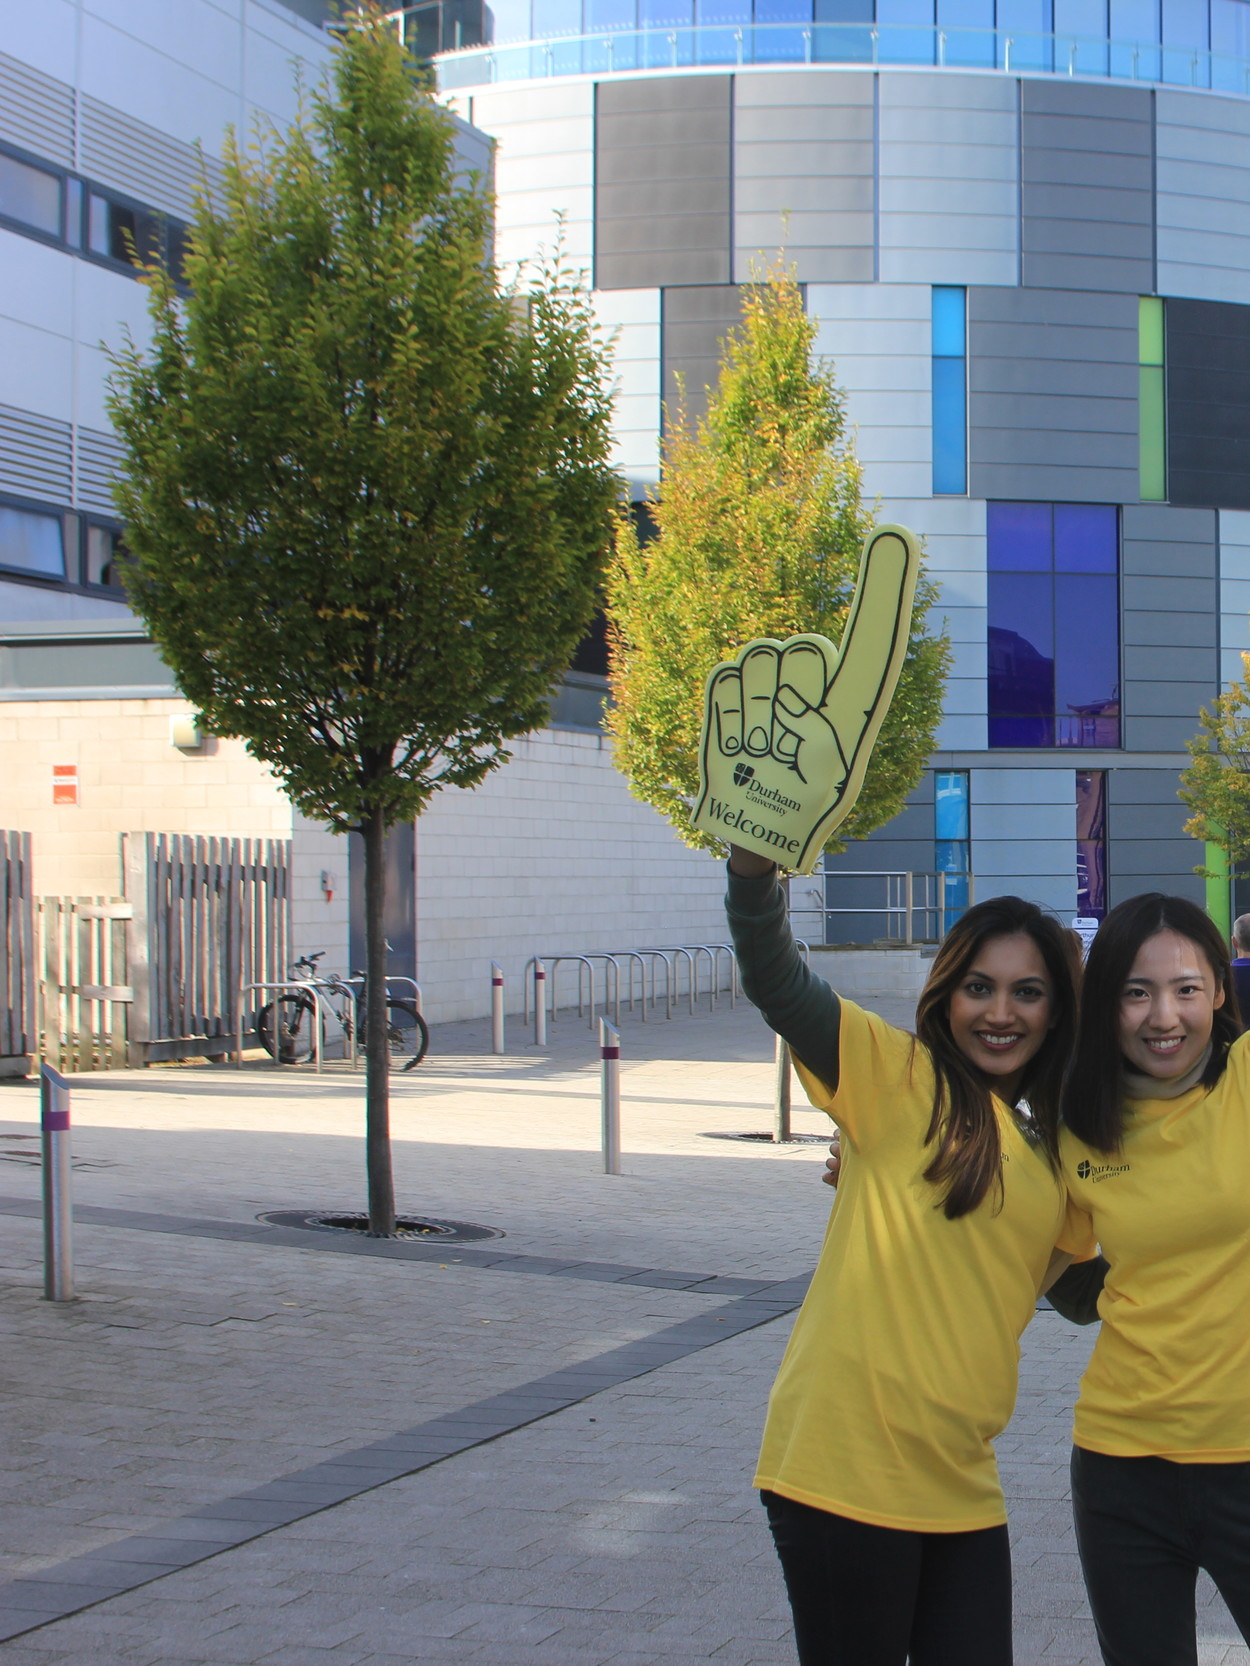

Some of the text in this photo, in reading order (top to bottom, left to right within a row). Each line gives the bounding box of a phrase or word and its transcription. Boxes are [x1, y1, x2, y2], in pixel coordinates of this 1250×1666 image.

[745, 791, 788, 817] University
[748, 779, 801, 812] Durham
[709, 797, 800, 854] Welcome
[1090, 1164, 1130, 1176] Durham
